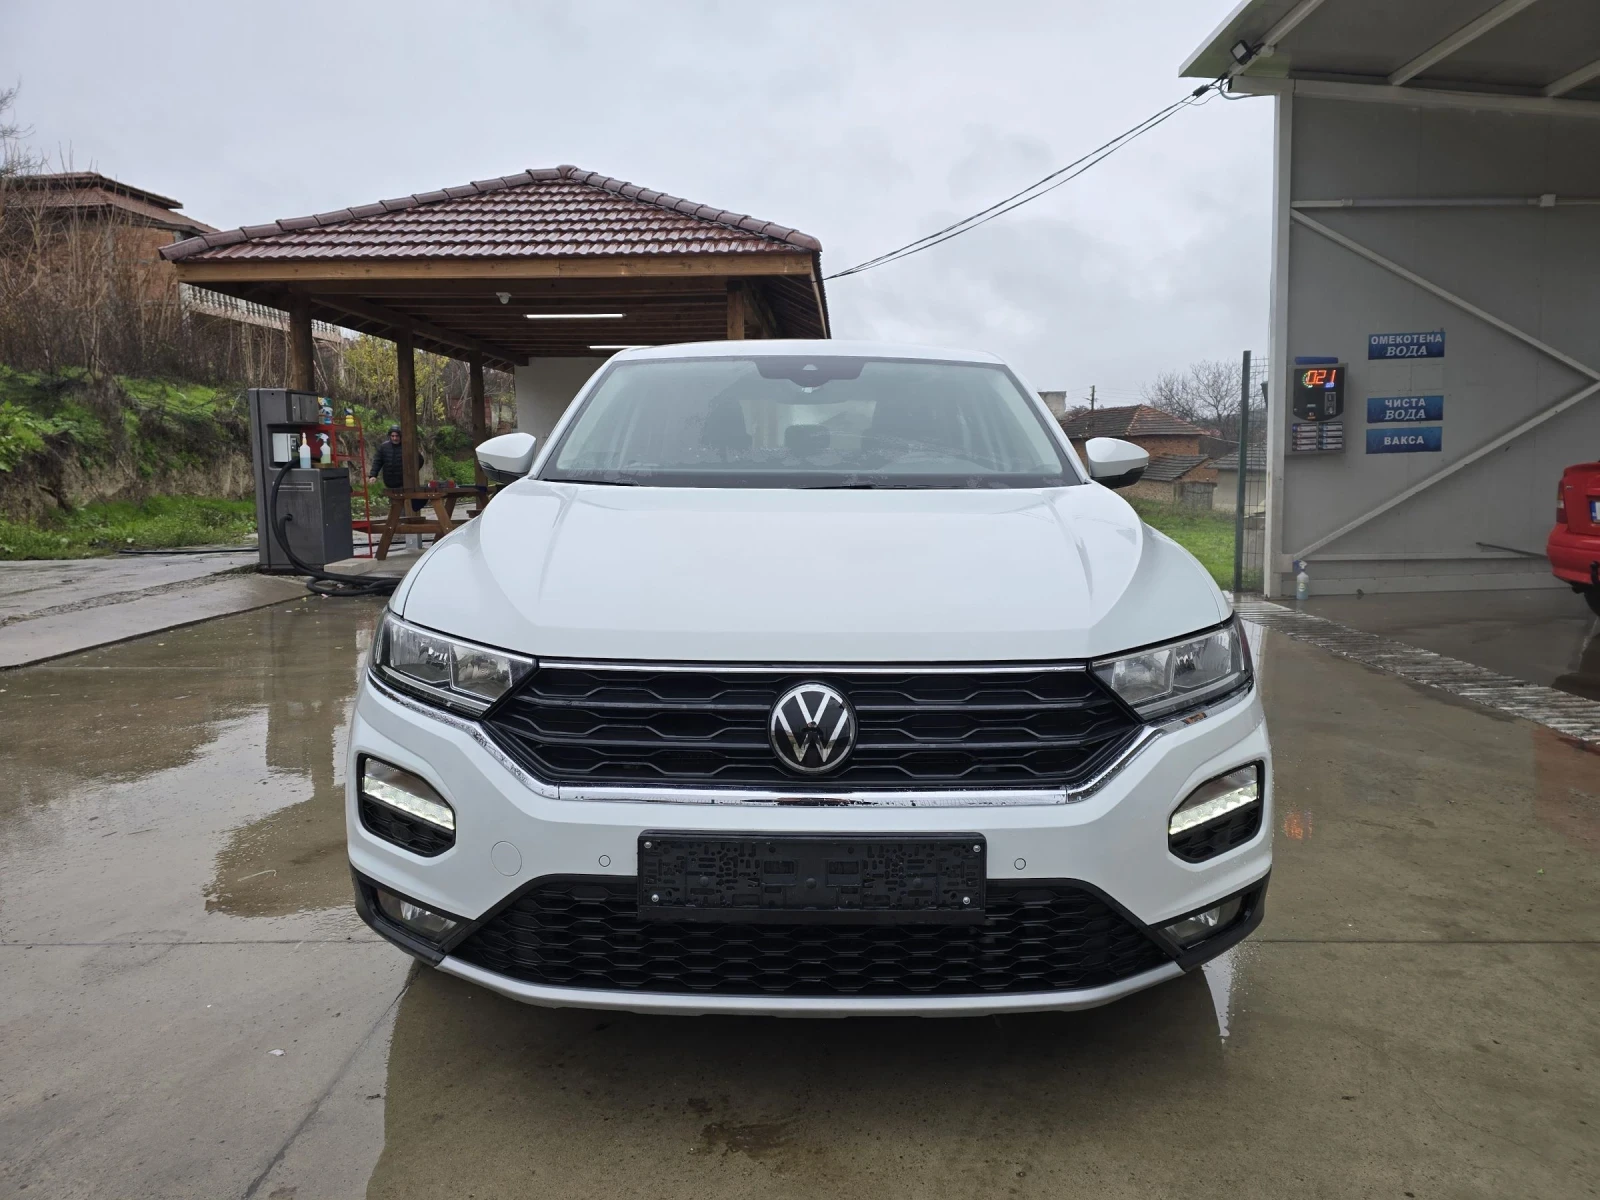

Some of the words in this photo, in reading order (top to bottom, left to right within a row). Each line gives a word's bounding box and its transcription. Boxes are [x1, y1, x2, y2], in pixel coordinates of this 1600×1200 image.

[1371, 334, 1442, 345] ОМЕКОТЕНА
[1385, 345, 1427, 357] ВОДА
[1306, 369, 1337, 384] 021
[1385, 398, 1425, 407] ЧИСТА
[1384, 409, 1426, 421] ВОДА
[1384, 436, 1424, 445] ВАКСА
[773, 688, 852, 766] VW
